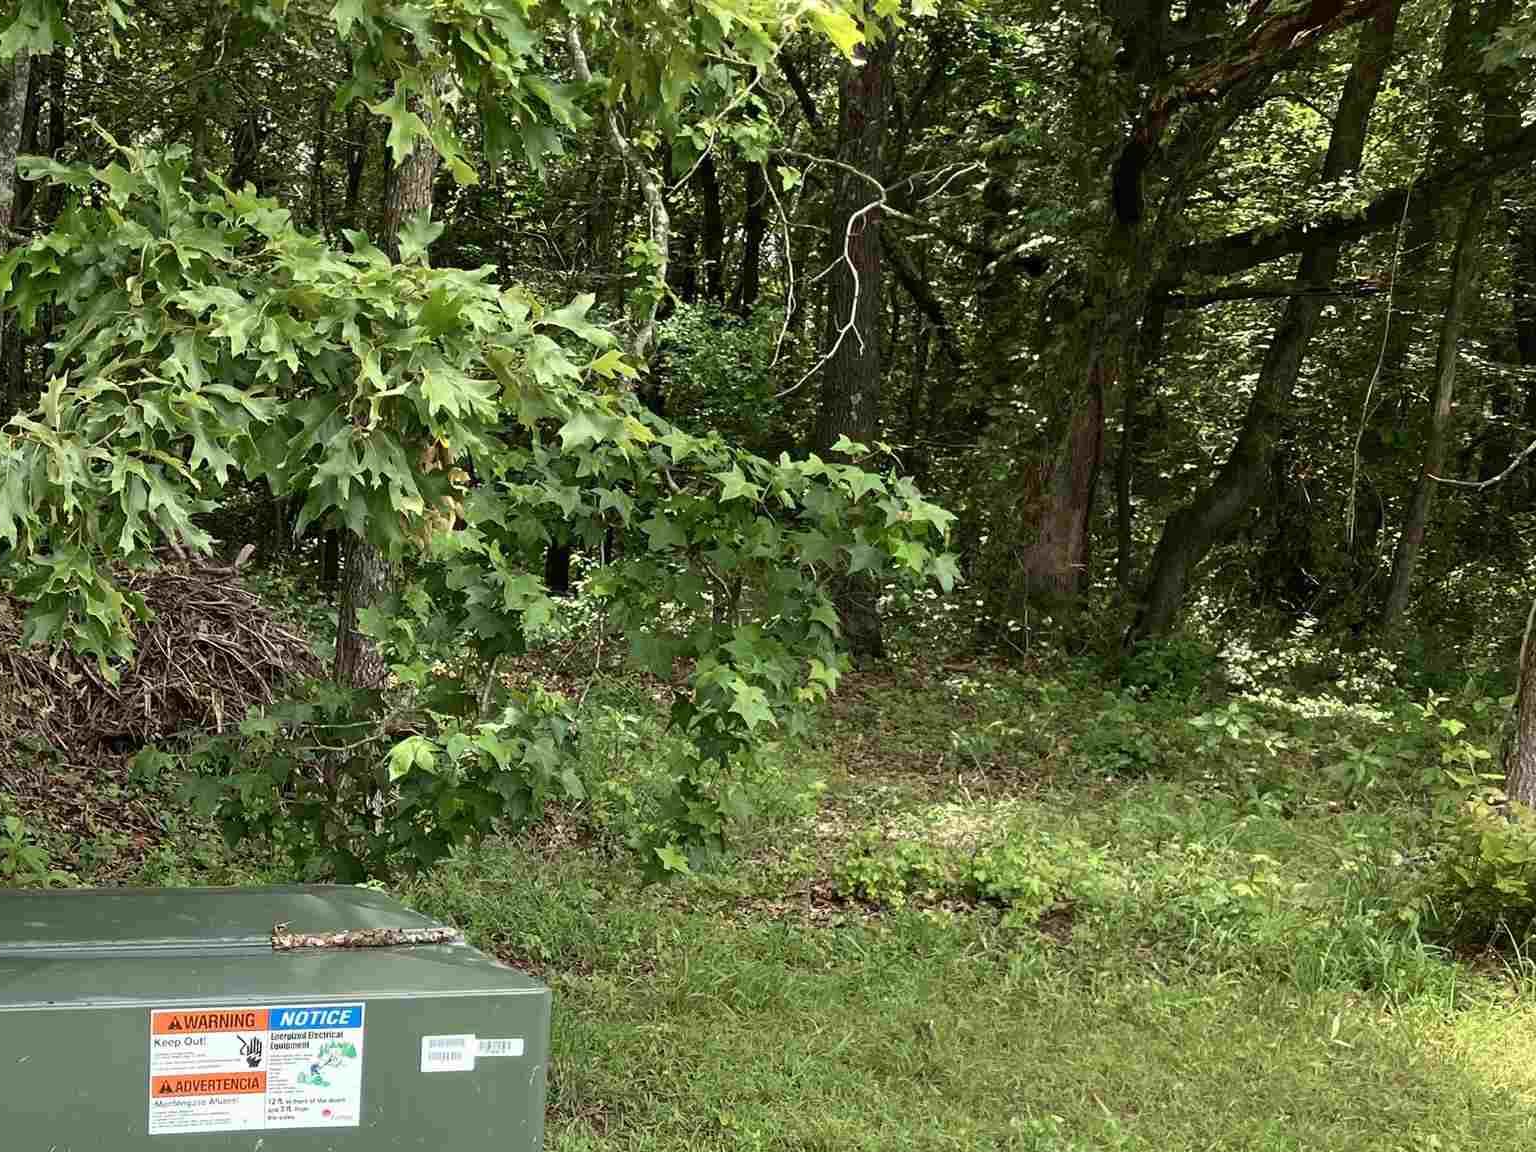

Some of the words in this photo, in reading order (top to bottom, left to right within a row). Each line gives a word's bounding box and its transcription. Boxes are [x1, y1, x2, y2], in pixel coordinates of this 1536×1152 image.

[182, 1012, 256, 1030] WARNING
[280, 1010, 353, 1026] NOTICE
[153, 1038, 182, 1049] Keep
[183, 1036, 207, 1047] Out!
[175, 1077, 260, 1093] ADVERTENCIA
